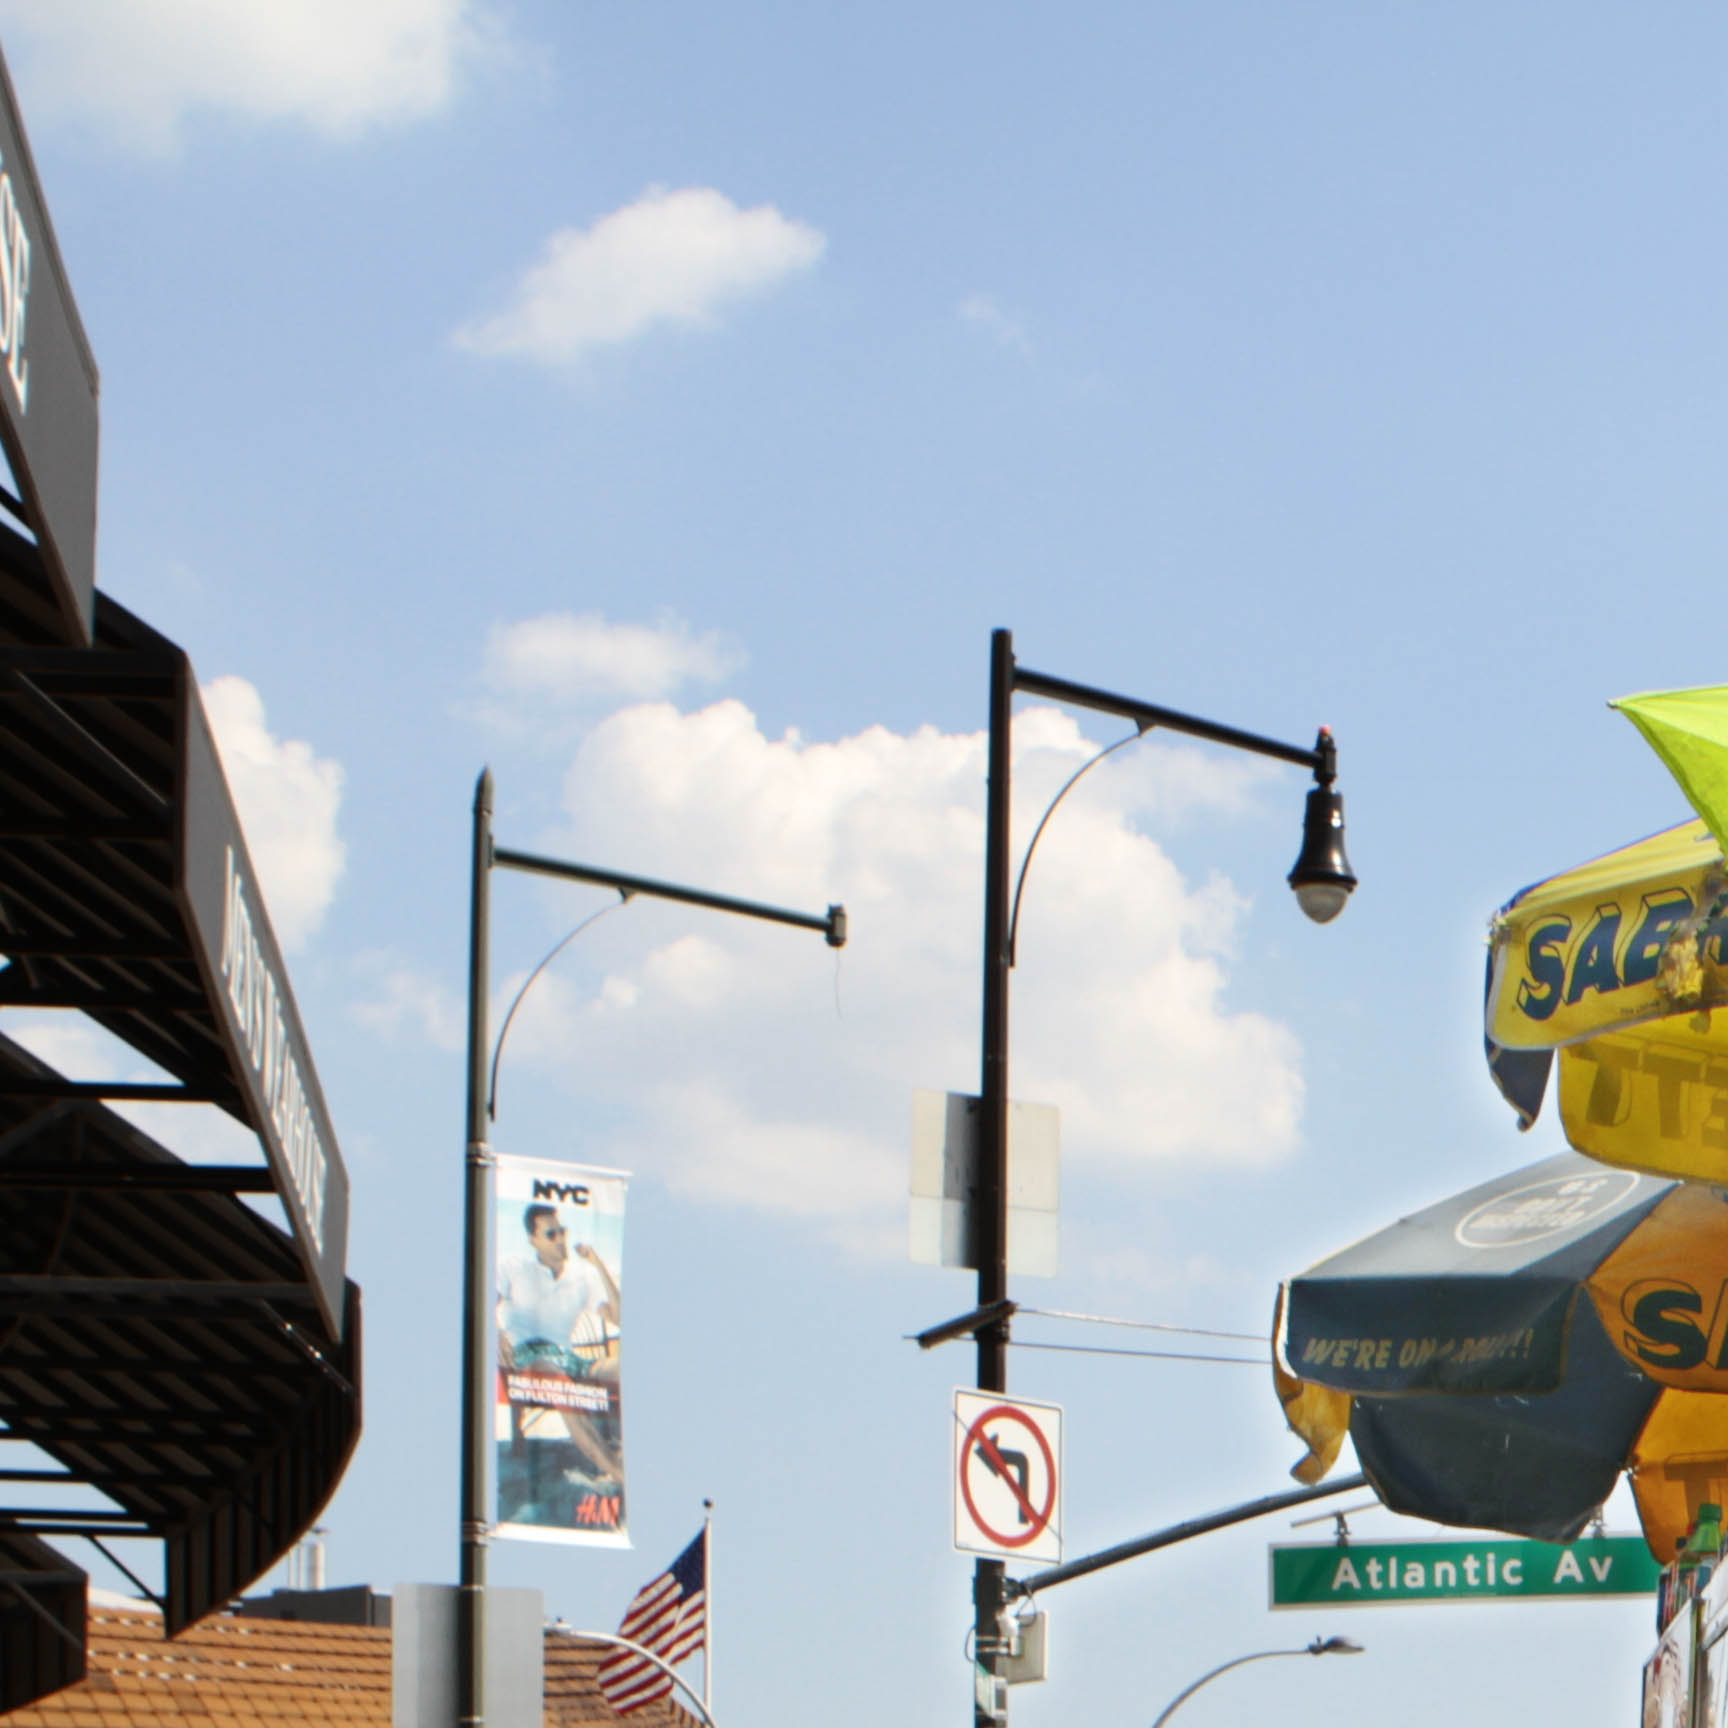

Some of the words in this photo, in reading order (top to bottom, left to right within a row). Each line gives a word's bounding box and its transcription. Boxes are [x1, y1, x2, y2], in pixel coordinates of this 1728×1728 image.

[533, 1178, 590, 1206] NYC
[1302, 1337, 1394, 1371] WE'RE
[1331, 1551, 1524, 1591] Atlantic
[1553, 1549, 1614, 1584] Av
